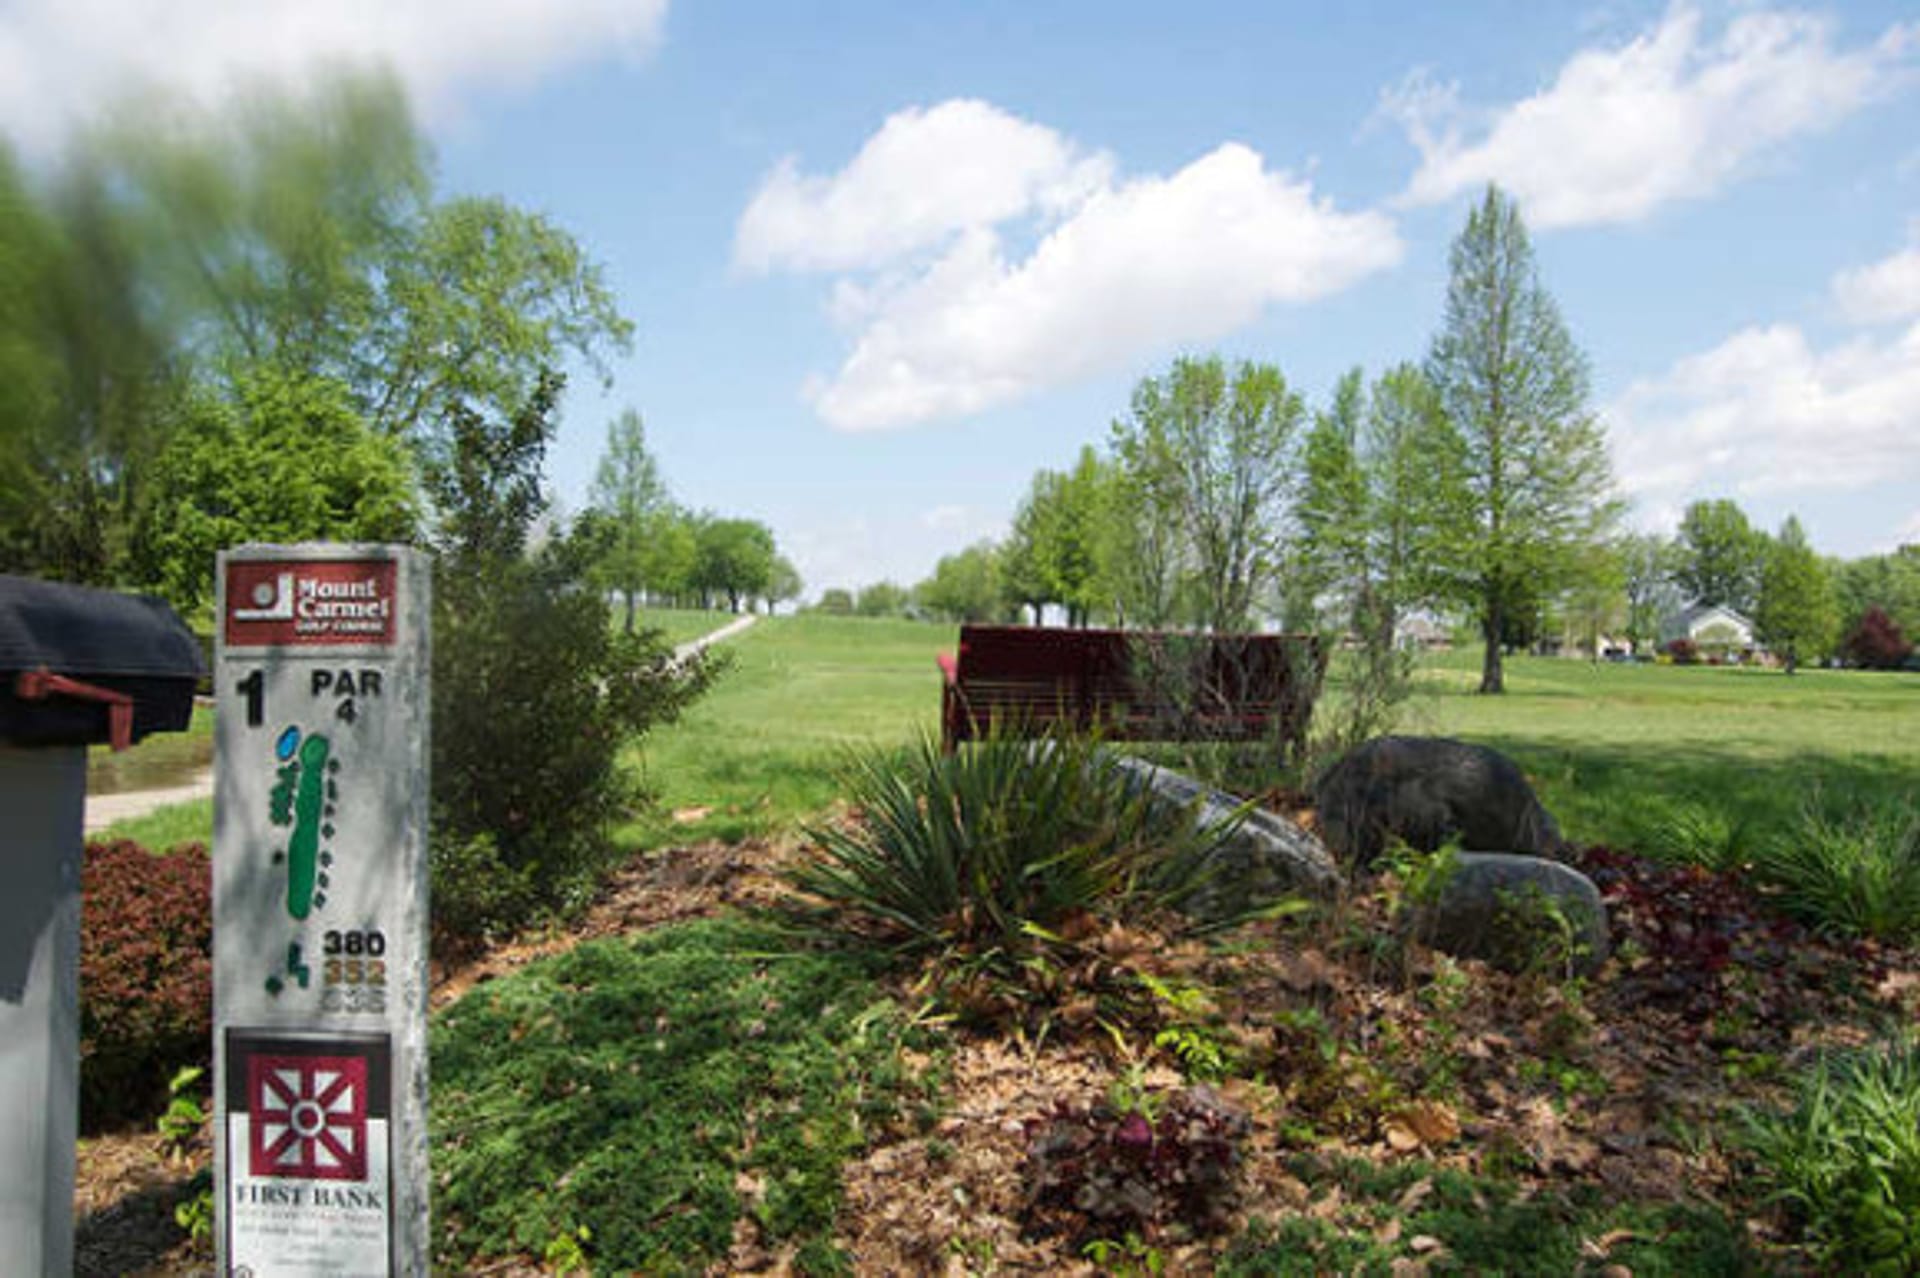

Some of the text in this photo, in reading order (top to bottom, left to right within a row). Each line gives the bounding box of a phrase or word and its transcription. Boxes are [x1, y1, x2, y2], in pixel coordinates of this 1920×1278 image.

[299, 578, 377, 597] Mount
[298, 599, 389, 618] Carmel
[311, 670, 382, 696] PAR
[236, 669, 263, 726] 1
[336, 699, 356, 723] 4
[324, 929, 385, 957] 380
[236, 1185, 382, 1209] FIRST BANK
